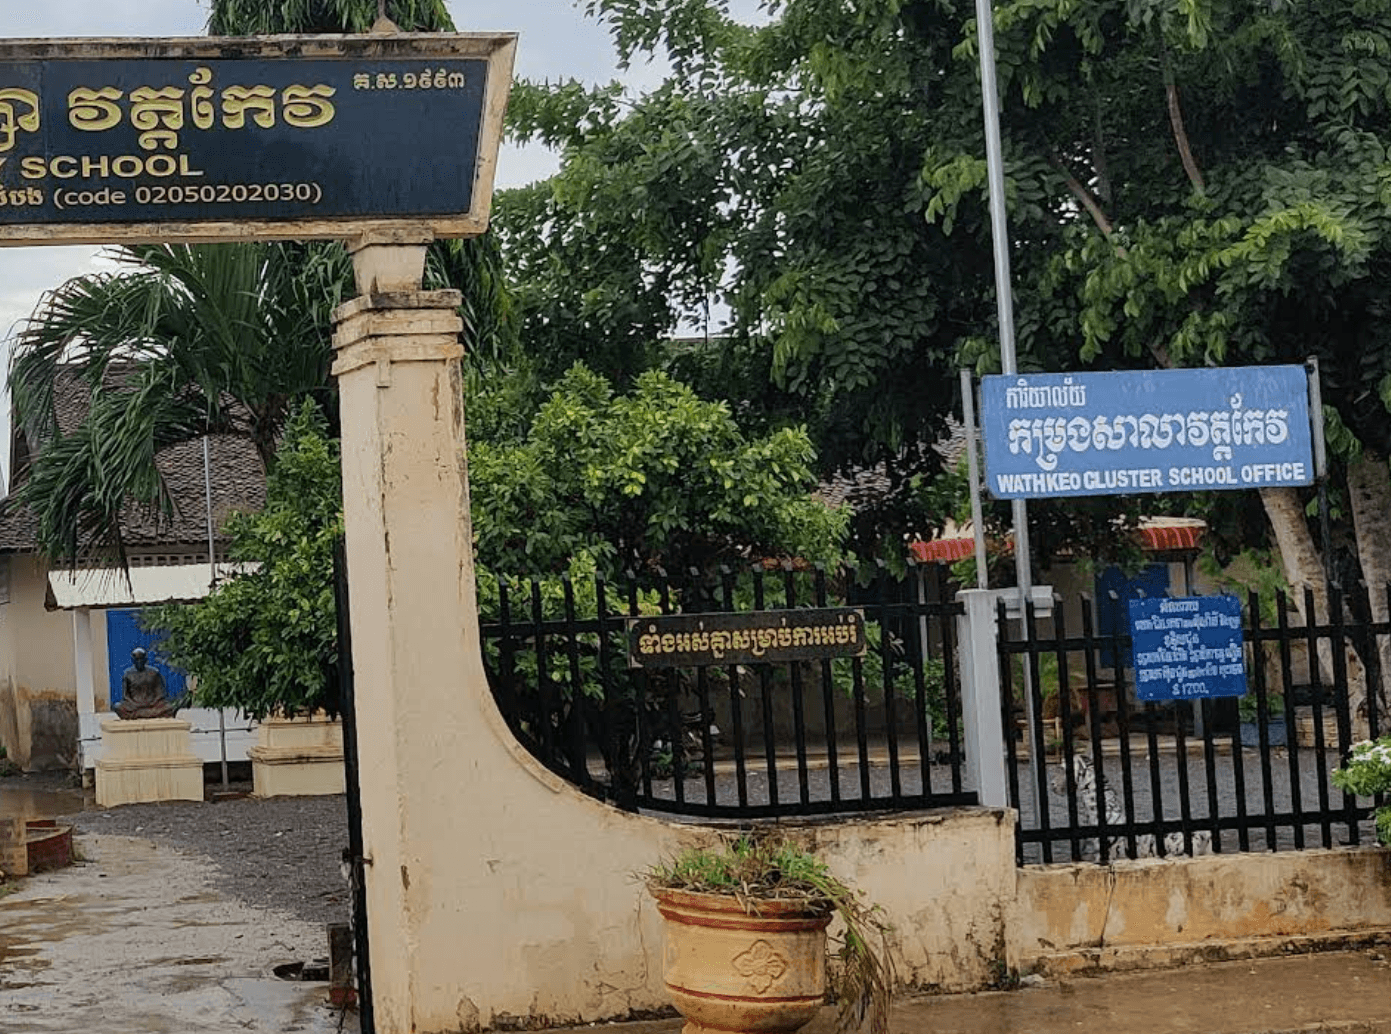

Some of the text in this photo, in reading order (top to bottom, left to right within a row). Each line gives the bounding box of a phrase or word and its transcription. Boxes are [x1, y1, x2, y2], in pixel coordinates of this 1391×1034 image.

[66, 66, 338, 150] វត្តកែវ
[20, 152, 205, 180] SCHOOL
[53, 187, 127, 209] (code
[135, 183, 322, 204] 02050202030)
[997, 472, 1081, 494] WATHKEO
[1168, 464, 1238, 488] SCHOOL
[1241, 461, 1306, 483] OFFICE
